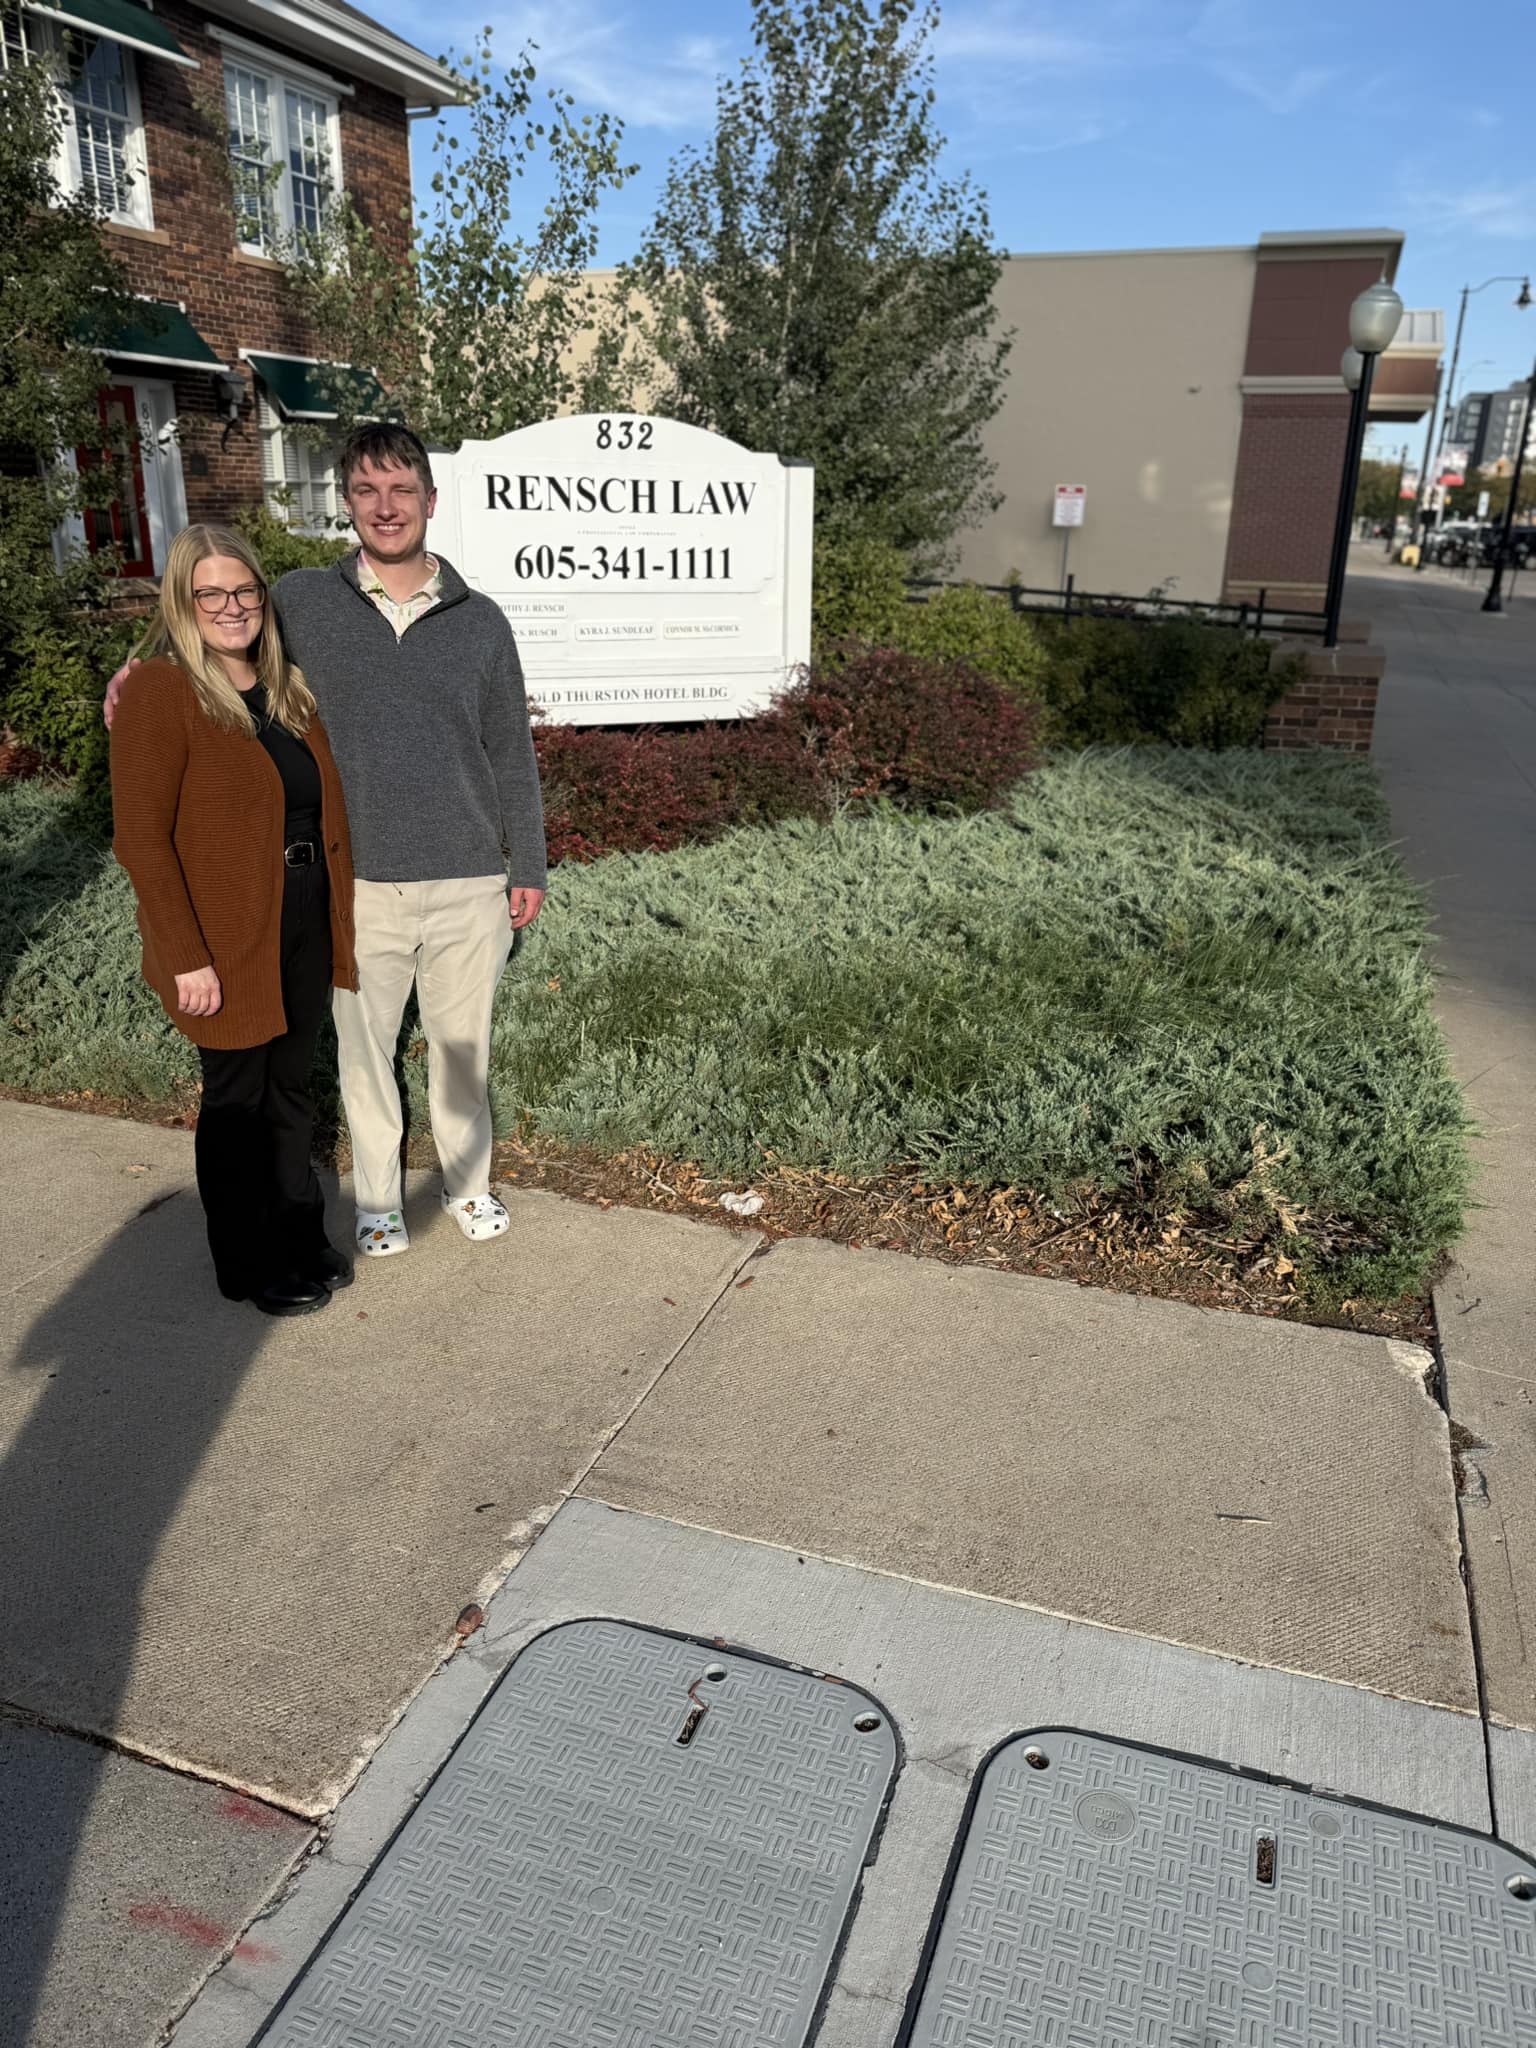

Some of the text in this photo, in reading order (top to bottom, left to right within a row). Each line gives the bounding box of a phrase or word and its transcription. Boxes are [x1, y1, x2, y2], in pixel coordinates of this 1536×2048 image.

[596, 419, 654, 450] 832
[484, 474, 757, 515] RENSCH LAW
[514, 544, 733, 580] 605-341-1111
[528, 628, 558, 637] RUSCH
[532, 686, 728, 703] OLD THURSTON HOTEL BLDG
